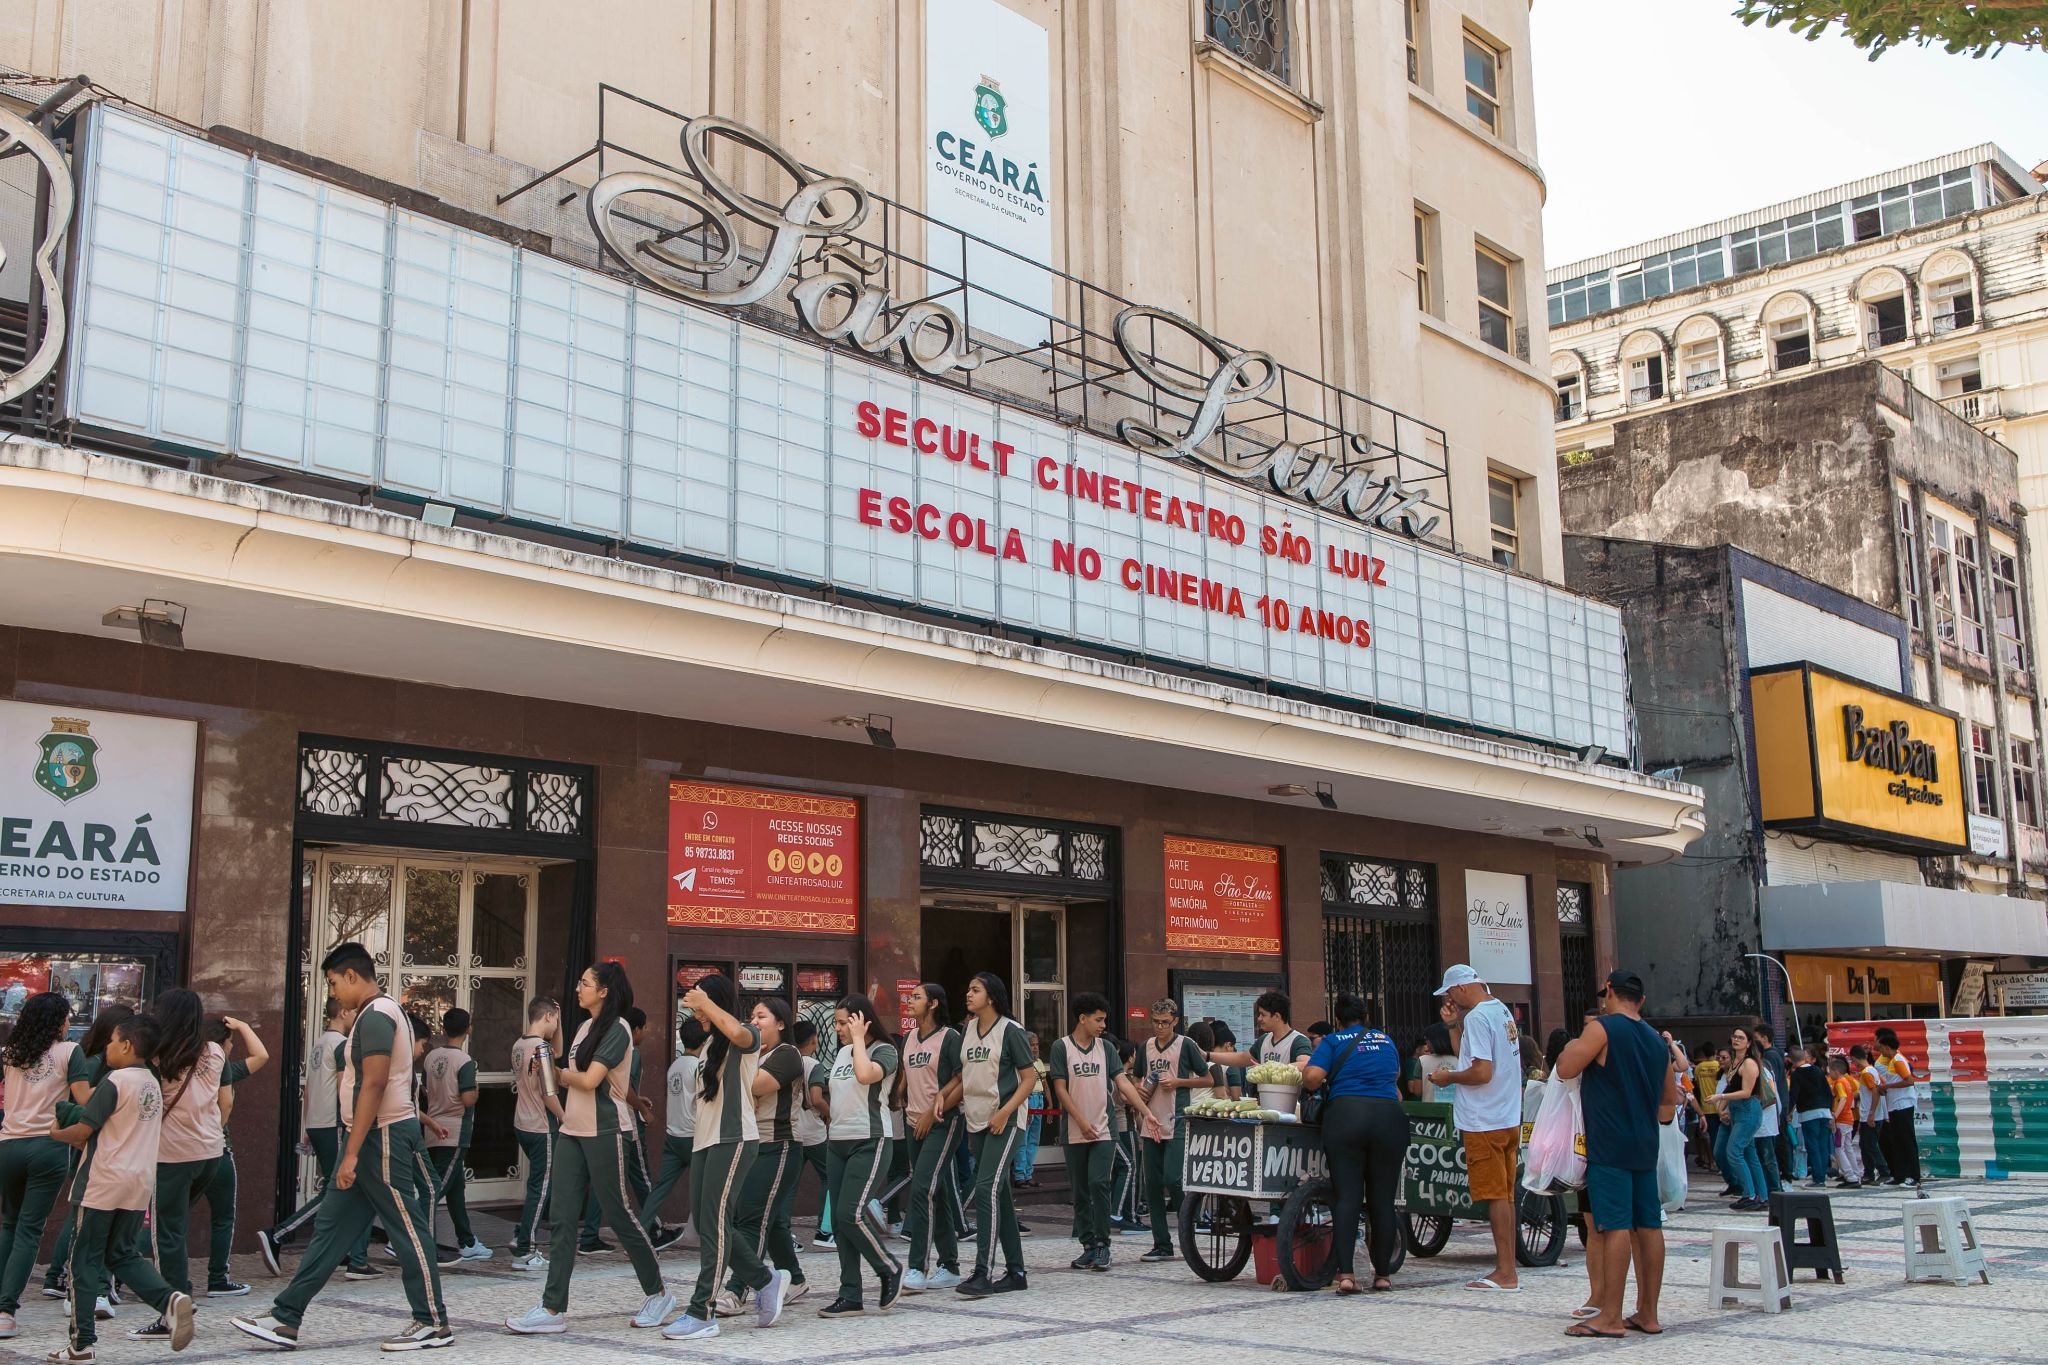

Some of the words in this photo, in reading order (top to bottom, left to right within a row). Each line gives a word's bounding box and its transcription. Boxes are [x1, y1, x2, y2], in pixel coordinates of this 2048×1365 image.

[936, 131, 1044, 202] CEARÁ
[936, 161, 987, 191] GOVERNO
[989, 185, 1004, 198] DO
[1007, 192, 1045, 216] ESTADO
[954, 187, 991, 209] SECRETARIA
[991, 203, 1000, 212] DA
[1000, 207, 1027, 223] CULTURA
[586, 114, 983, 376] São
[1113, 304, 1441, 539] Luiz
[857, 400, 1015, 477] SECULT
[1037, 456, 1246, 546] CINETEATRO
[1261, 522, 1312, 565] SÃO
[1328, 545, 1387, 587] LUIZ
[859, 488, 1028, 564] ESCOLA
[1053, 538, 1101, 581] NO
[1122, 558, 1246, 619] CINEMA
[1257, 594, 1290, 632] 10
[1299, 606, 1371, 648] ANOS
[1841, 704, 1939, 783] BanBan
[768, 818, 804, 833] ACESSE
[806, 822, 843, 837] NOSSAS
[0, 812, 162, 866] EARÁ
[684, 832, 702, 842] ENTRE
[702, 834, 711, 842] EM
[711, 835, 736, 844] CONTATO
[777, 833, 803, 844] REDES
[804, 836, 834, 848] SOCIAIS
[684, 846, 694, 858] 85
[1168, 859, 1190, 872] ARTE
[57, 866, 84, 880] DO
[90, 868, 161, 884] ESTADO
[710, 876, 736, 886] TEMOS!
[767, 875, 843, 889] CINETEATROSAOLUIZ
[1169, 877, 1204, 892] CULTURA
[1213, 872, 1242, 897] São
[1242, 875, 1273, 901] Luiz
[58, 891, 73, 899] DA
[76, 891, 125, 902] CULTURA
[1169, 895, 1208, 910] MEMÓRIA
[1467, 899, 1494, 926] São
[1494, 901, 1524, 928] Luiz
[1170, 915, 1219, 930] PATRIMÔNIO
[738, 971, 781, 982] BILHETERIA
[1847, 965, 1891, 996] BaBan
[908, 1051, 932, 1067] EGM
[967, 1046, 992, 1060] EGM
[1263, 1051, 1282, 1063] EGM
[833, 1063, 855, 1077] EG
[1072, 1062, 1101, 1075] EGM
[1150, 1058, 1171, 1072] EGM
[1190, 1134, 1252, 1158] MILHO
[1192, 1160, 1248, 1187] VERDE
